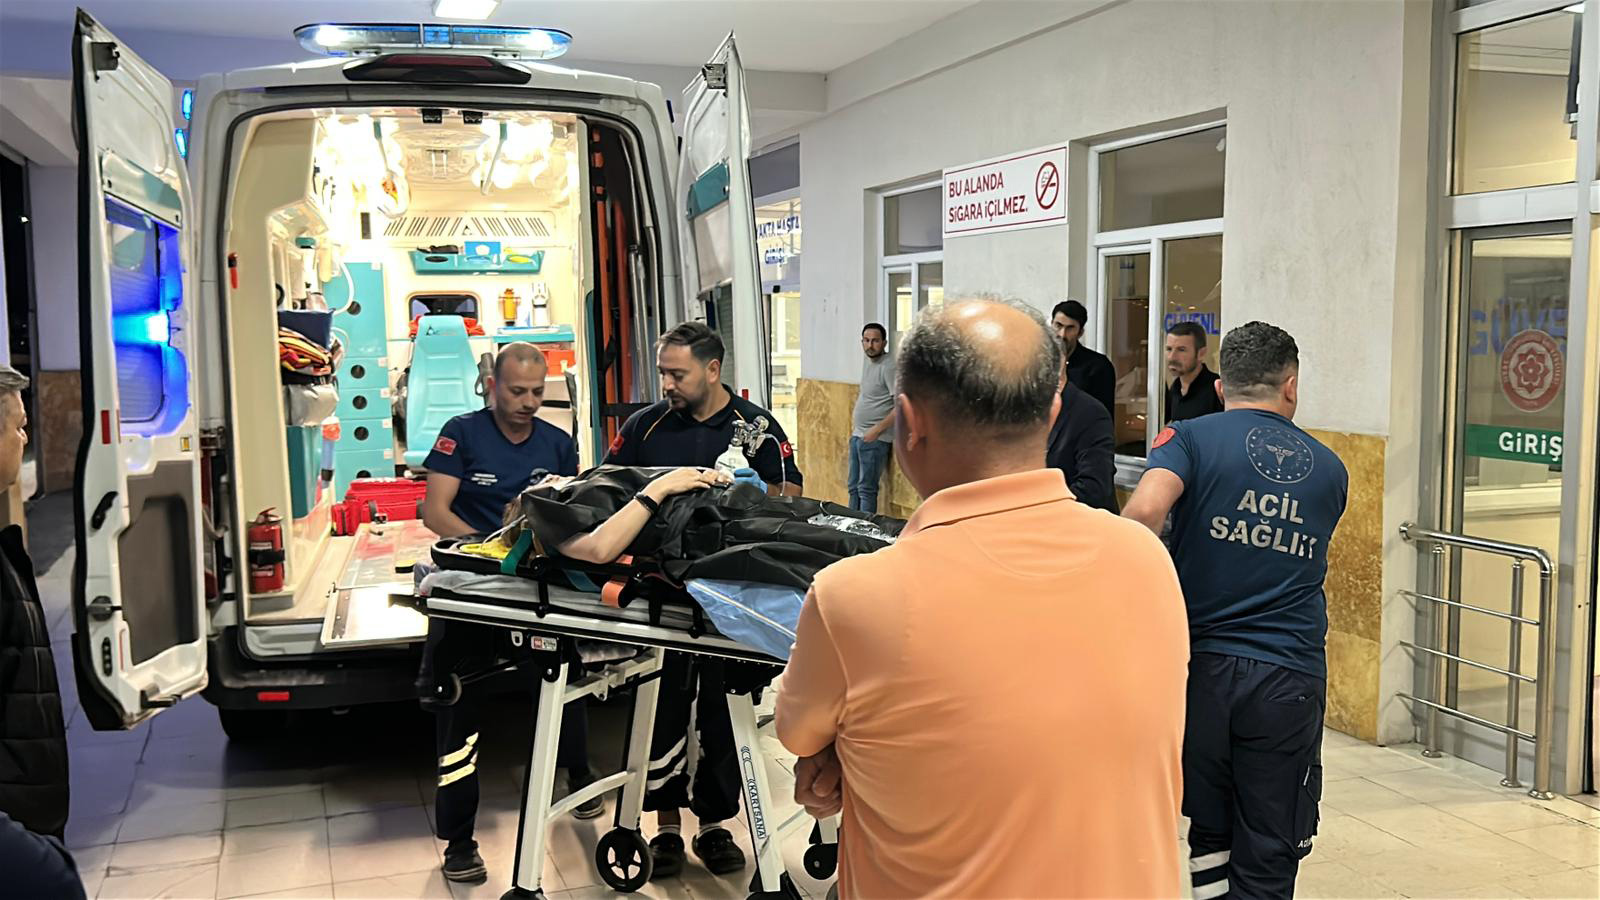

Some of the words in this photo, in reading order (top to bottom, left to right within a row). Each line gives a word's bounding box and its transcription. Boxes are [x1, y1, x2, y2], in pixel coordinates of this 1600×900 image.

[949, 180, 962, 198] BU
[964, 171, 1004, 195] ALANDA
[949, 202, 983, 223] SİGARA
[984, 195, 1028, 221] İÇİLMEZ.
[1498, 431, 1563, 462] GİRİŞ
[1236, 489, 1304, 525] ACİL
